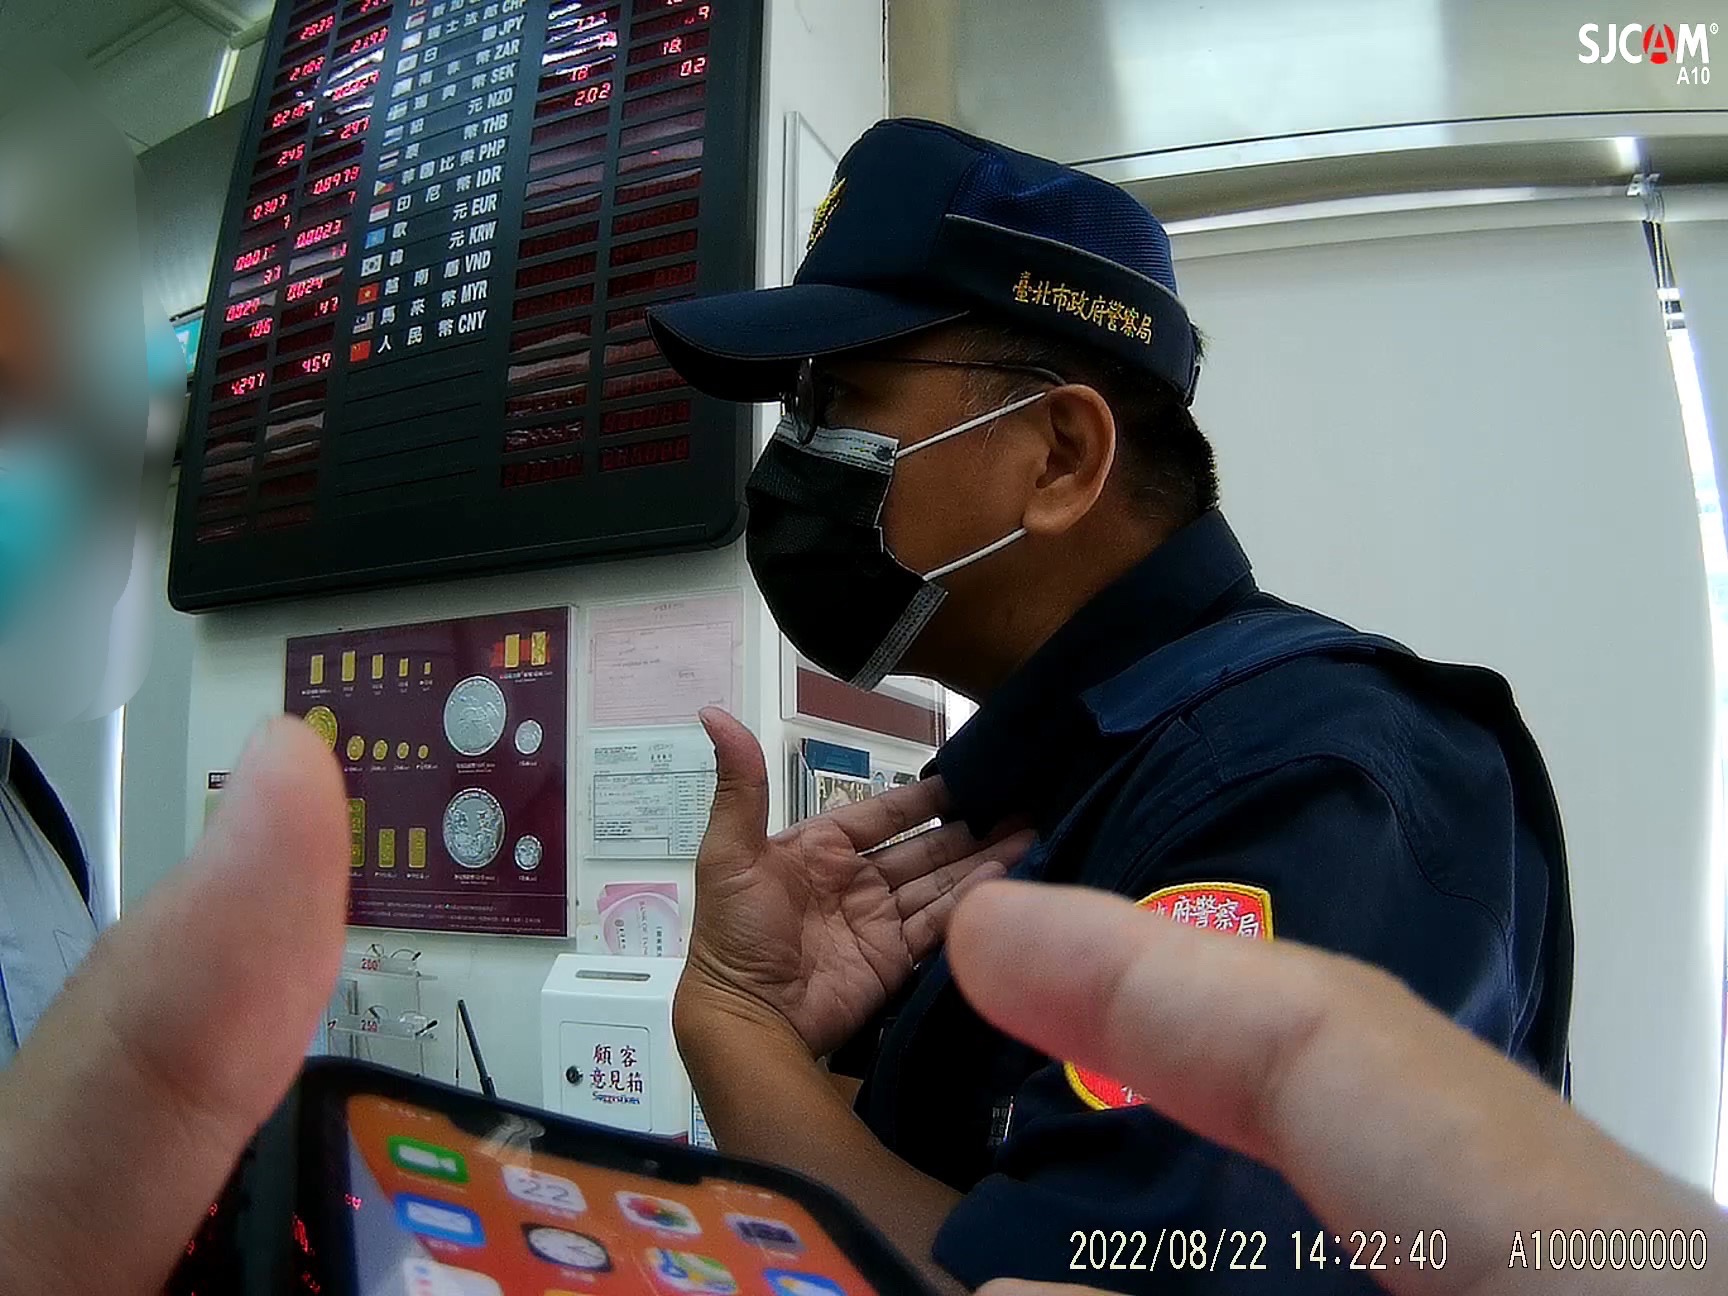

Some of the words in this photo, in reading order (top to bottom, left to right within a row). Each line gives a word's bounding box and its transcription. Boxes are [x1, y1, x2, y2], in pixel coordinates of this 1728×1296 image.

[498, 14, 525, 36] JPY
[494, 39, 520, 61] ZAR
[490, 62, 516, 84] SEK
[487, 86, 513, 109] NZD
[482, 113, 508, 134] THB
[478, 138, 506, 161] PHP
[476, 165, 502, 188] IDR
[471, 193, 498, 217] EUR
[468, 221, 497, 245] KRW
[465, 250, 491, 273] VND
[461, 280, 488, 304] MYR
[1012, 270, 1153, 345] 臺北市政府警察局
[458, 309, 487, 334] CNY
[1152, 894, 1259, 940] 府警察局
[593, 1044, 637, 1067] 顧客
